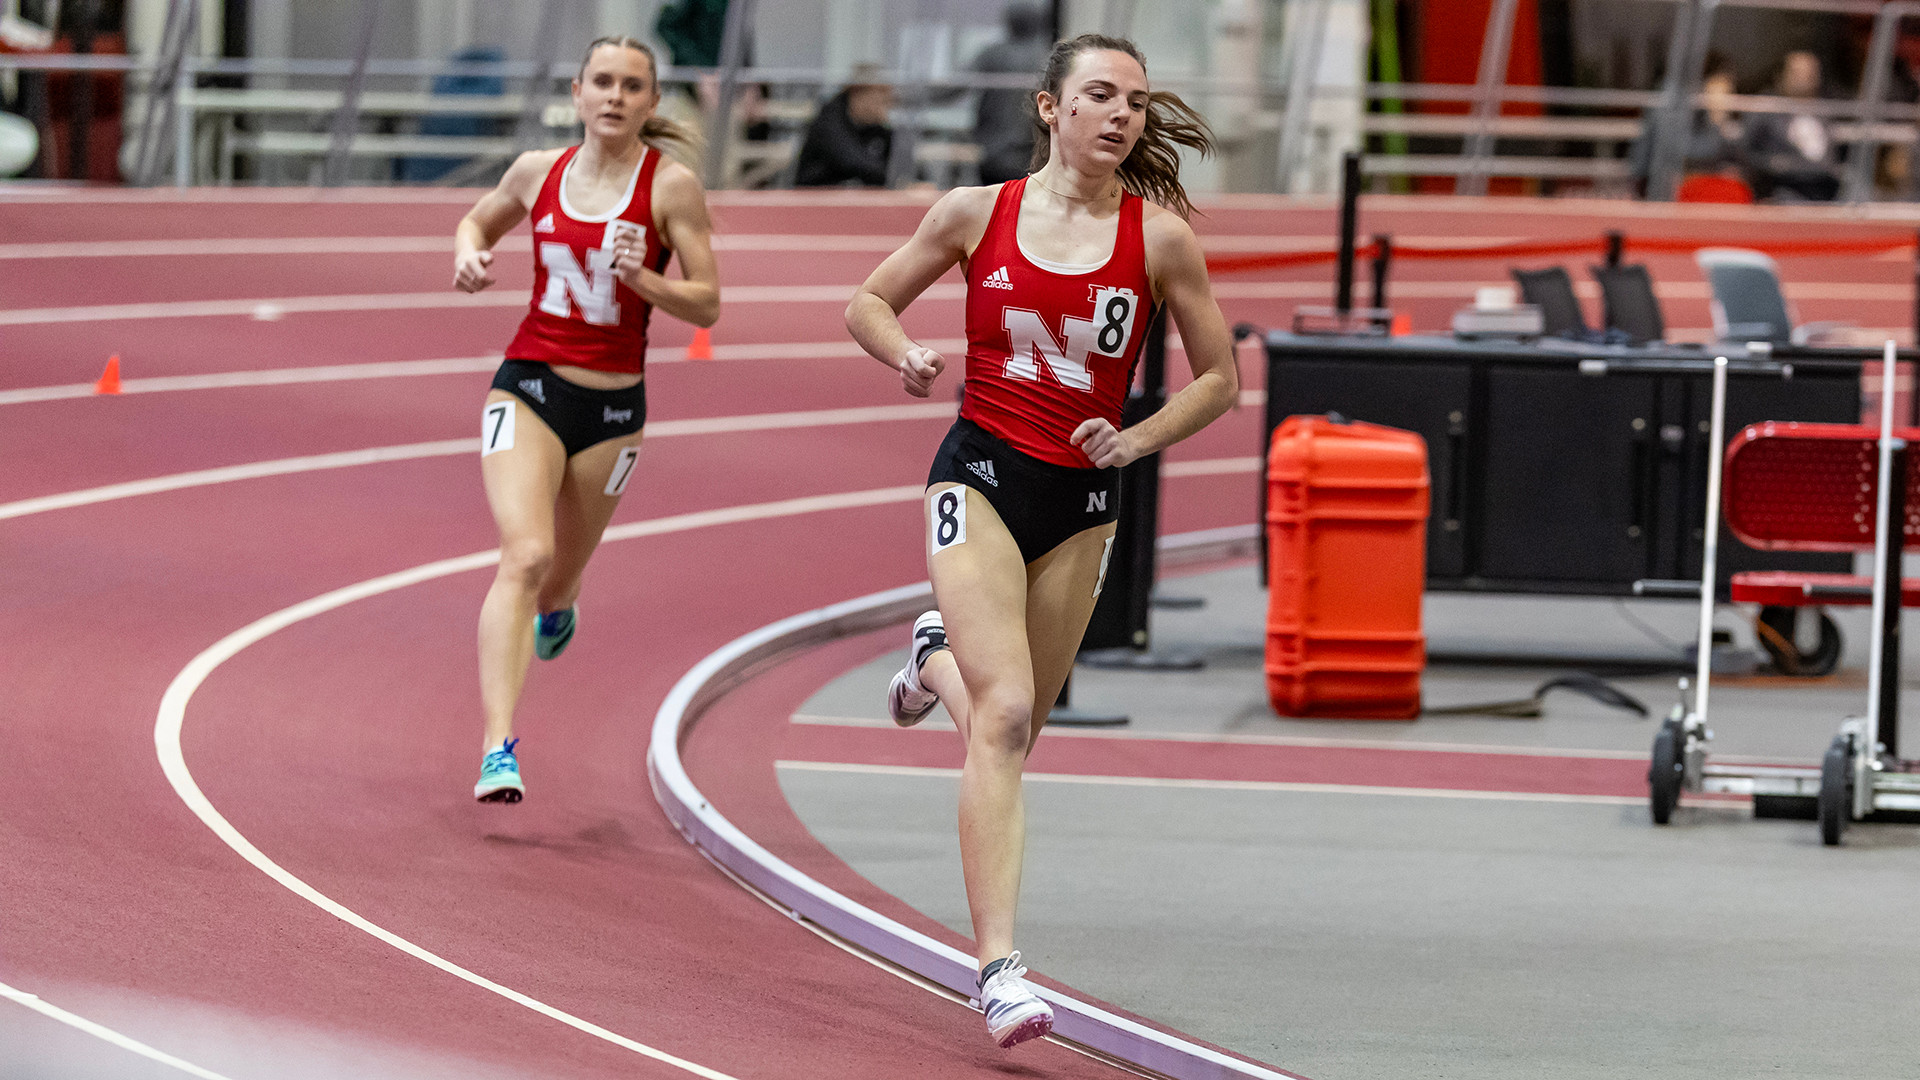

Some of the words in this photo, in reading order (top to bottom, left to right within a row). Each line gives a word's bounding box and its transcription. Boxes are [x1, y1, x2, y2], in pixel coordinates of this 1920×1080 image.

[538, 240, 621, 326] N
[982, 279, 1014, 291] adidas
[1098, 296, 1130, 353] 8
[1001, 305, 1095, 394] N
[489, 406, 506, 449] 7
[614, 451, 637, 492] 7
[966, 463, 998, 488] adidas
[937, 491, 958, 546] 8
[1085, 490, 1107, 512] N
